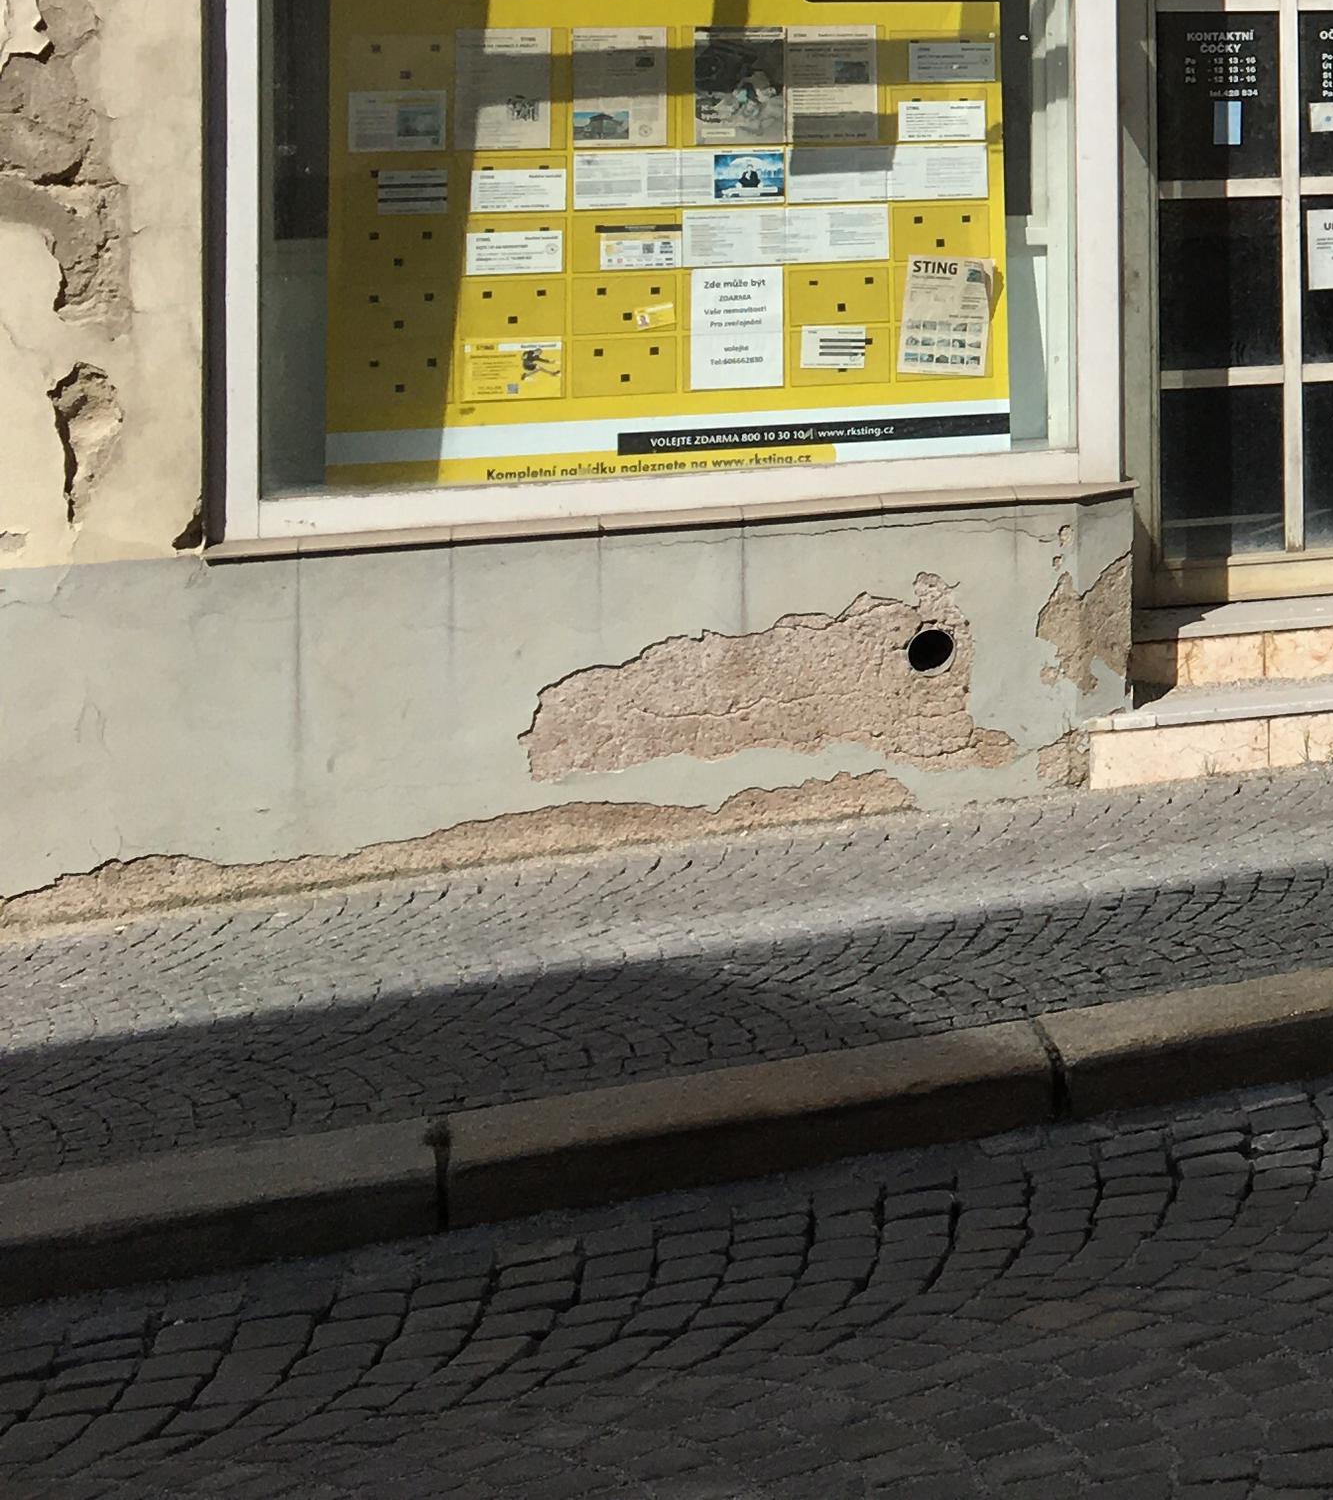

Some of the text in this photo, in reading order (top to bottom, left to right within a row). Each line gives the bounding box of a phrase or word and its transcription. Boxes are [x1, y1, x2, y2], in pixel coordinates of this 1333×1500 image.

[1186, 29, 1254, 42] KONTAKTNÍ
[1200, 42, 1242, 54] ČOČKY
[1228, 56, 1239, 64] 13
[912, 260, 959, 276] STING
[704, 280, 721, 289] Zde
[650, 425, 895, 449] VOLEJTE ZDARMA 800 10 30 10 www.rksting.cz
[486, 466, 557, 482] Kompletní
[620, 460, 687, 474] naleznete
[690, 460, 708, 470] na
